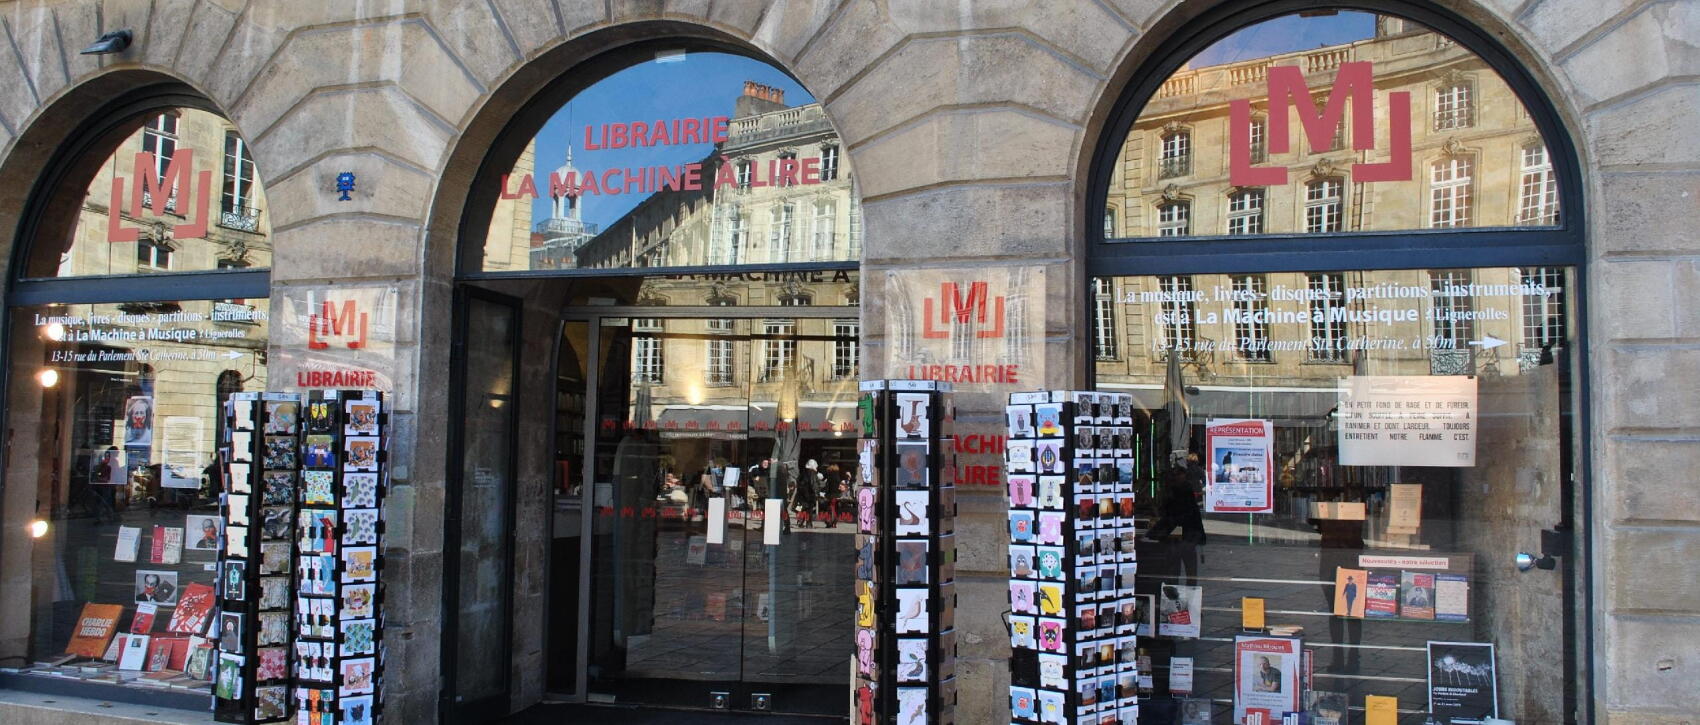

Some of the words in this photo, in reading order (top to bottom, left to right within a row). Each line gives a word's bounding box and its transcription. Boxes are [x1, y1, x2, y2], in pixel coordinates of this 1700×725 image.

[584, 116, 729, 151] LIBRAIRIE
[500, 173, 539, 200] LA
[549, 164, 702, 197] MACHINE
[714, 154, 739, 190] À
[751, 157, 820, 187] LIRE
[1115, 287, 1136, 304] La
[1140, 286, 1209, 306] musique,
[1214, 285, 1256, 302] livres
[1271, 285, 1330, 305] disques
[1347, 281, 1428, 304] partitions
[1444, 280, 1551, 298] instruments,
[35, 314, 47, 326] La
[48, 312, 85, 328] musique,
[118, 311, 150, 326] disques
[159, 310, 202, 325] partitions
[1154, 311, 1176, 325] est
[1177, 308, 1190, 324] à
[1196, 309, 1217, 325] La
[1223, 307, 1308, 325] Machine
[1312, 307, 1325, 323] à
[1330, 306, 1418, 326] Musique
[1436, 307, 1508, 324] Lignerolles
[76, 329, 89, 341] La
[91, 327, 137, 341] Machine
[138, 326, 146, 340] à
[148, 327, 197, 342] Musique
[206, 327, 246, 340] Lignerolles
[1194, 341, 1216, 351] rue
[1218, 336, 1236, 351] du
[1239, 336, 1308, 351] Parlement
[1412, 336, 1422, 350] à
[51, 350, 73, 362] 13-15
[74, 353, 87, 361] rue
[87, 349, 97, 361] du
[99, 349, 136, 361] Parlement
[297, 370, 376, 387] LIBRAIRIE
[908, 364, 1019, 383] LIBRAIRIE
